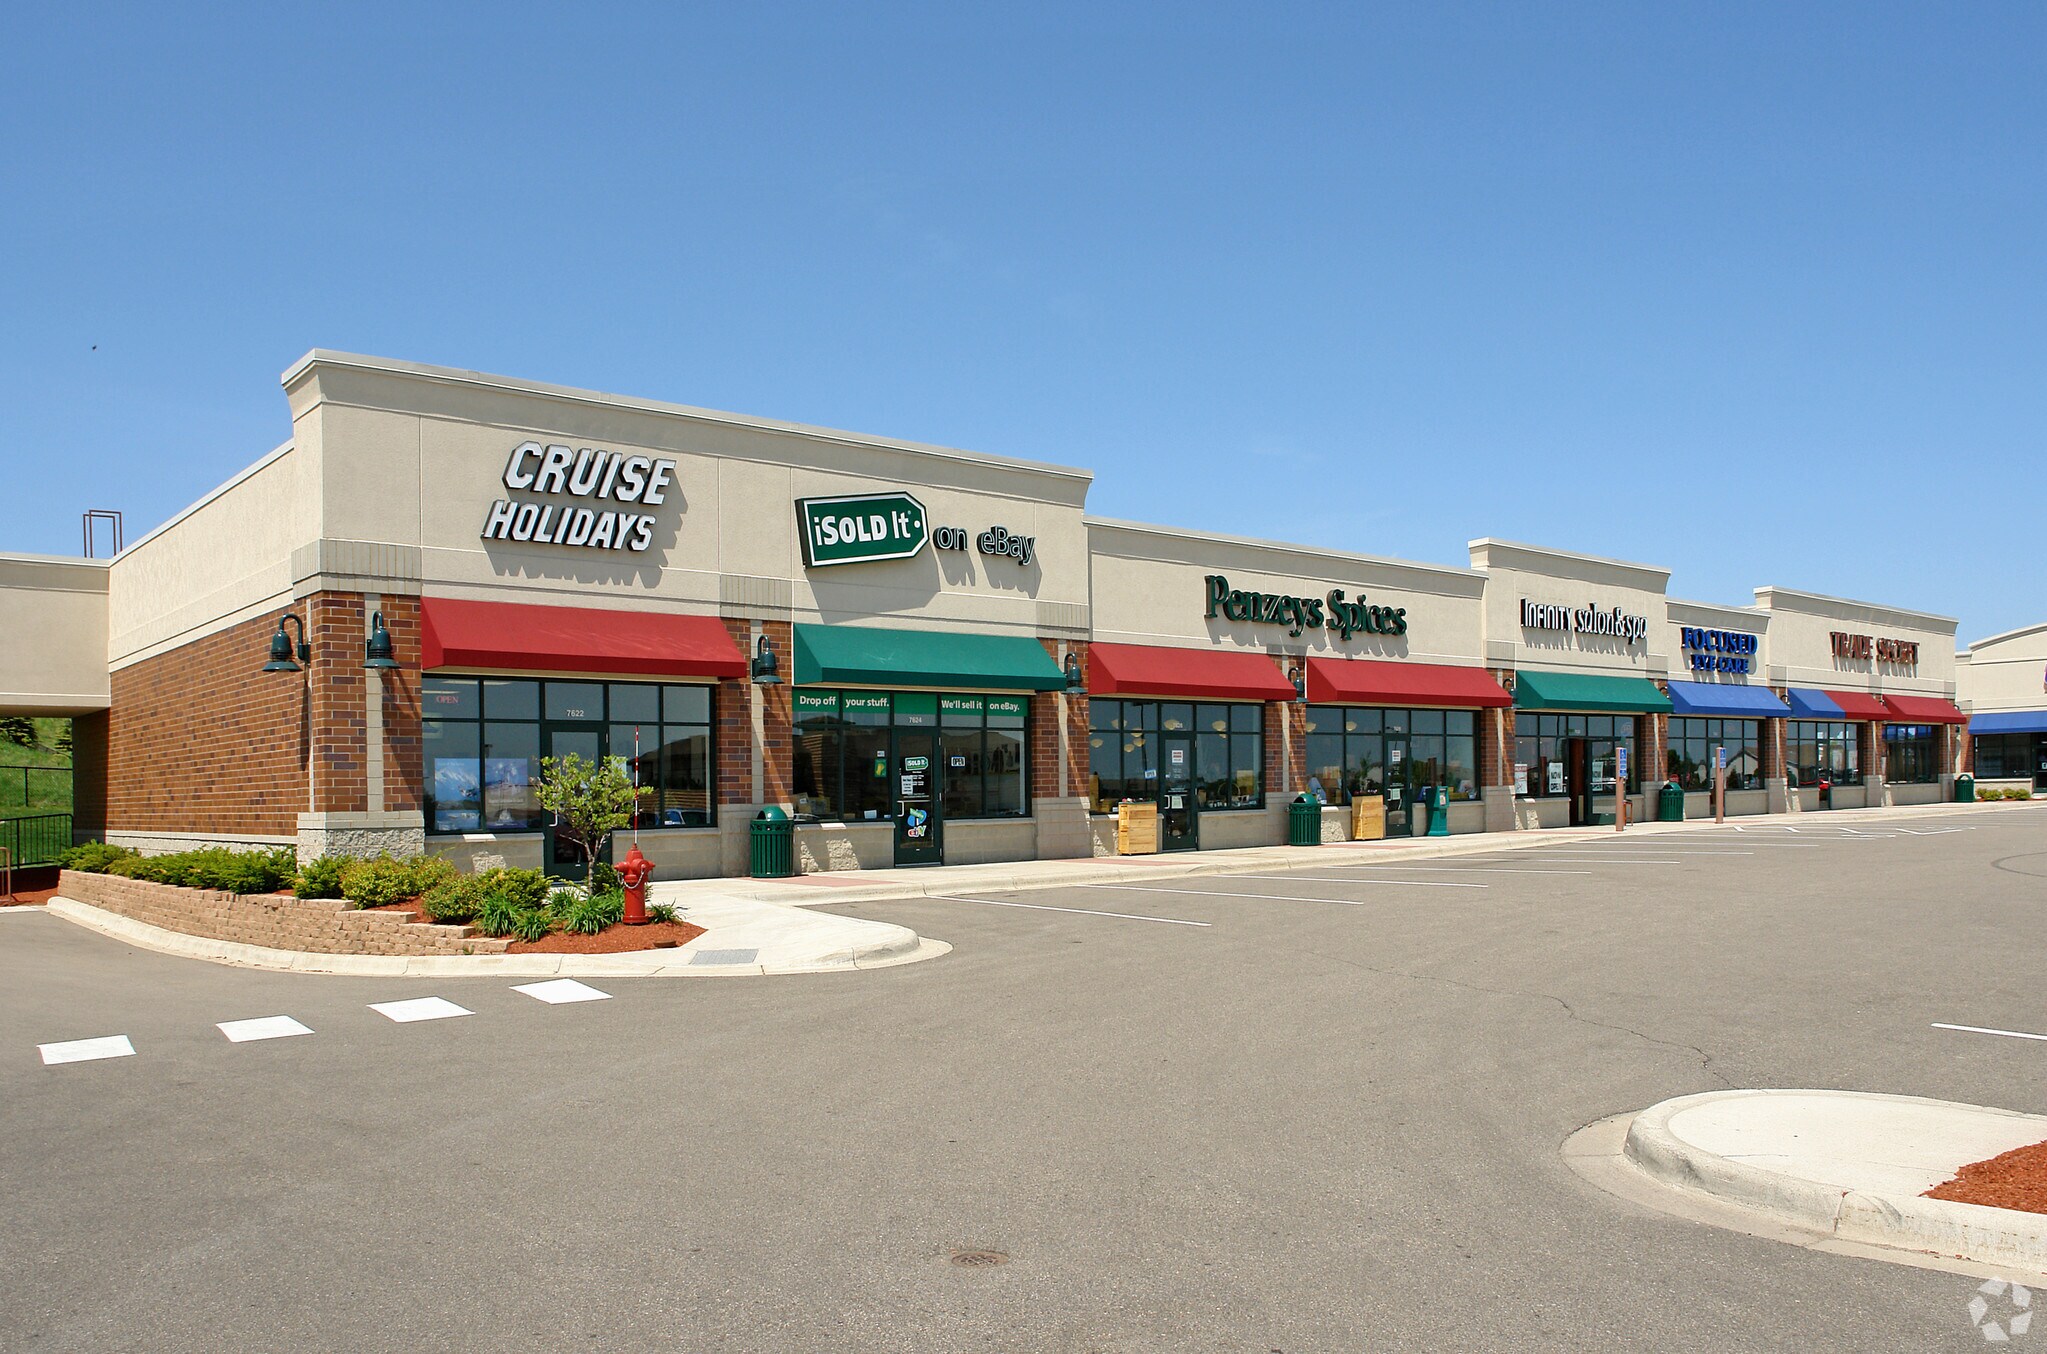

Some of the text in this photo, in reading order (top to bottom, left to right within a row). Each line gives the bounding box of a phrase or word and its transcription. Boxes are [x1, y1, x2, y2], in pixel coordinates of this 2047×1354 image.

[502, 441, 676, 505] CRUISE
[480, 500, 656, 552] HOLIDAYS
[814, 510, 1036, 566] iSOLD It on eBay
[1204, 575, 1407, 641] Penzeys Spices
[1520, 598, 1573, 631] INFINITY
[1680, 627, 1758, 655] FOCUSED
[1829, 631, 1920, 664] TRADE SECRET
[1690, 654, 1749, 674] EYE CARE
[436, 695, 459, 704] OPEN
[566, 709, 584, 717] 7622
[800, 696, 821, 707] Drop
[822, 696, 836, 705] off
[845, 698, 865, 708] your
[867, 698, 890, 707] stuff.
[941, 700, 960, 709] We'll
[961, 700, 975, 709] sell
[976, 700, 983, 709] it
[1000, 702, 1020, 712] eBay.
